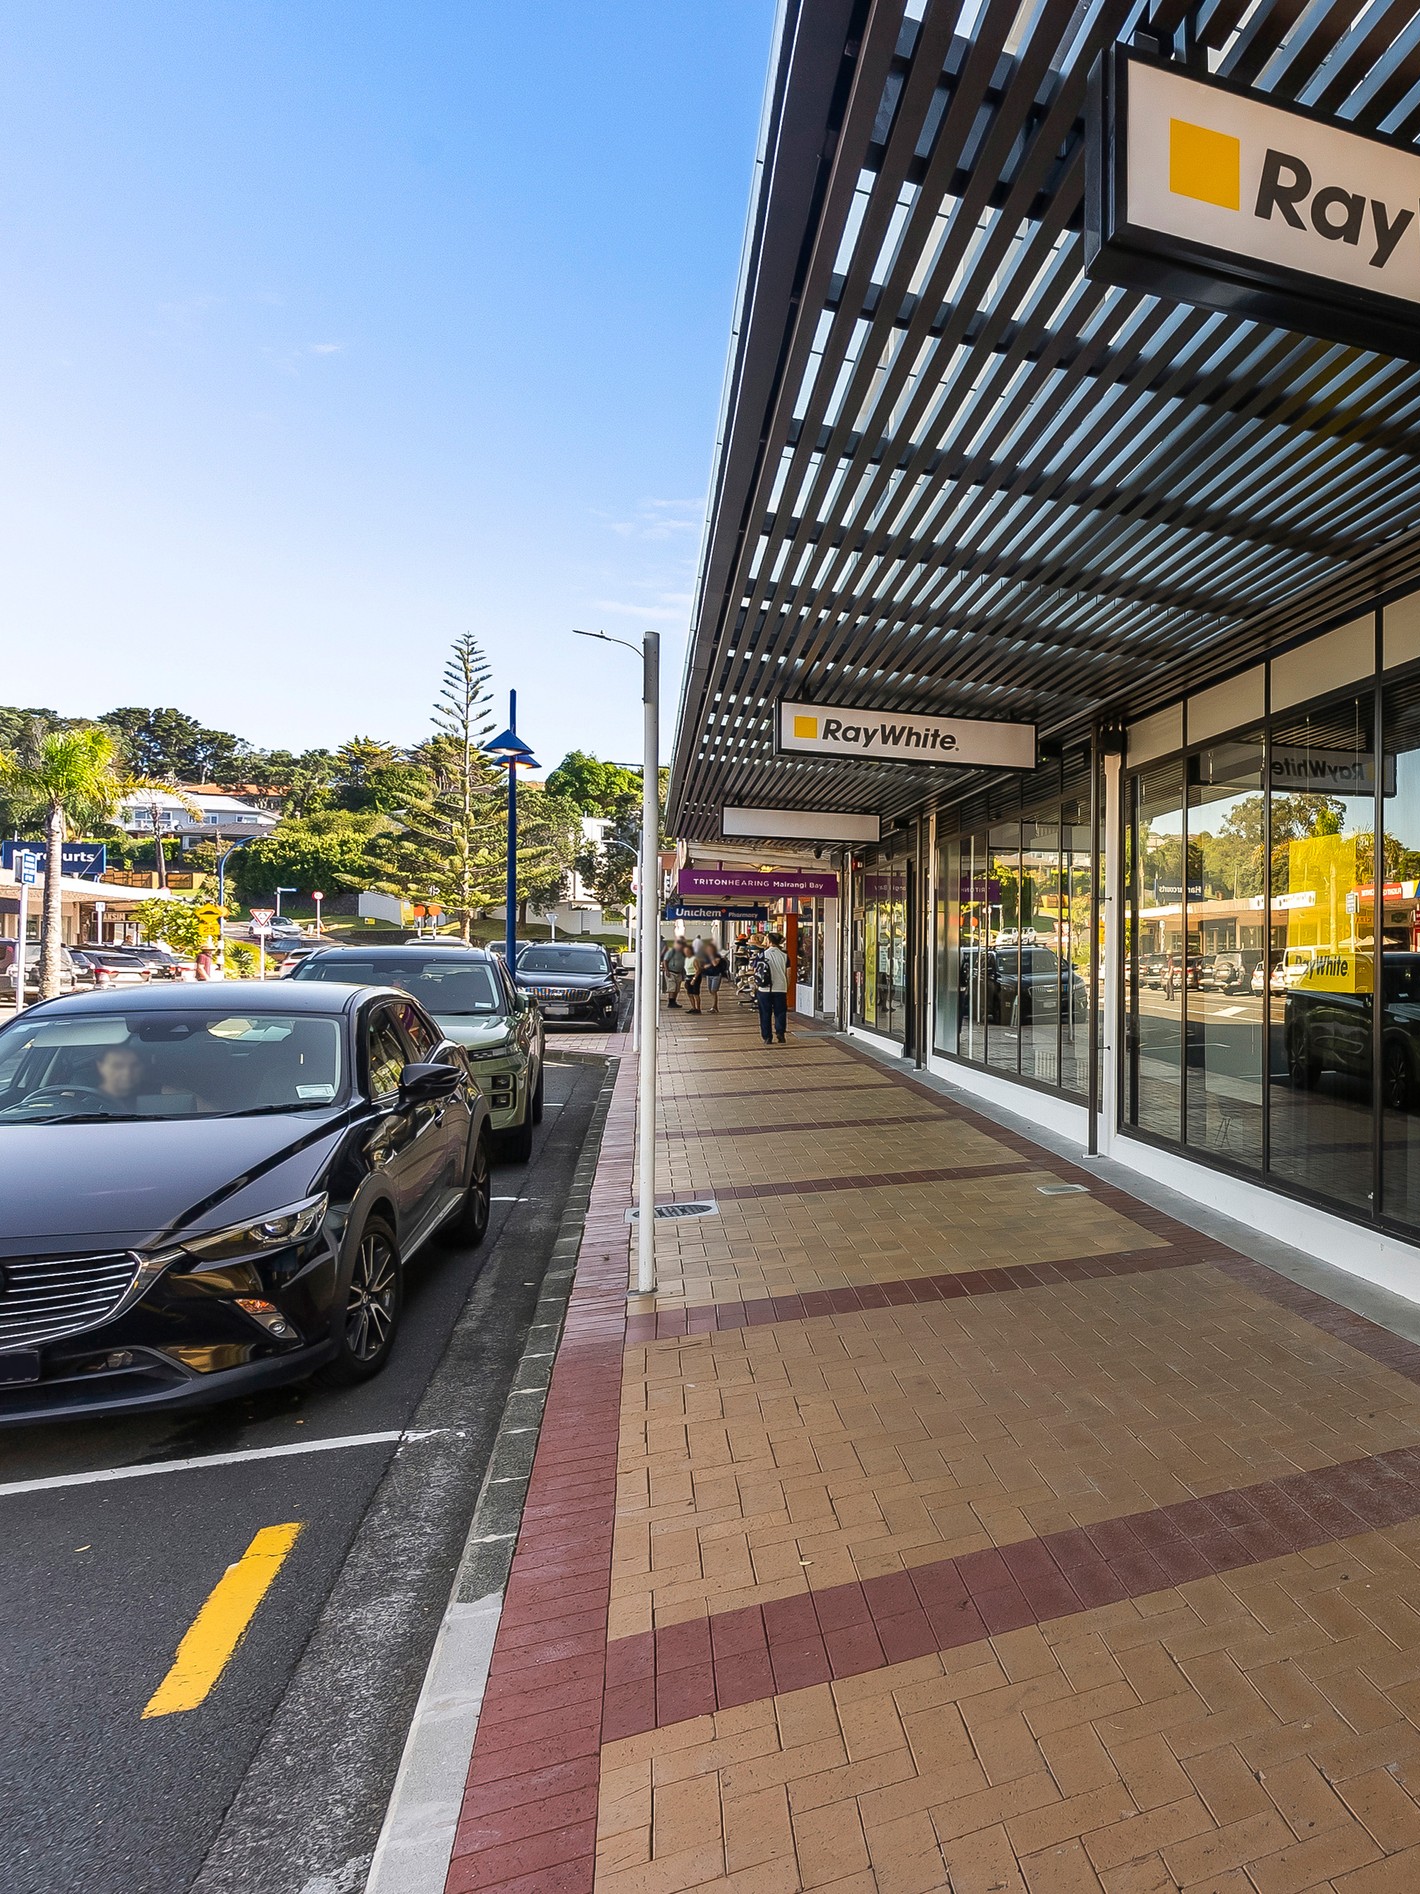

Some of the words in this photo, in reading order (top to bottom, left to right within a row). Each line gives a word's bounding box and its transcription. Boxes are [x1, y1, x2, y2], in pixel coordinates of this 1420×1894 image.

[822, 718, 957, 751] RayWhite
[773, 880, 807, 889] Mairangi
[809, 881, 824, 890] Bay
[675, 907, 722, 918] Unichem
[728, 911, 759, 920] Pharmacy
[202, 926, 216, 934] 25
